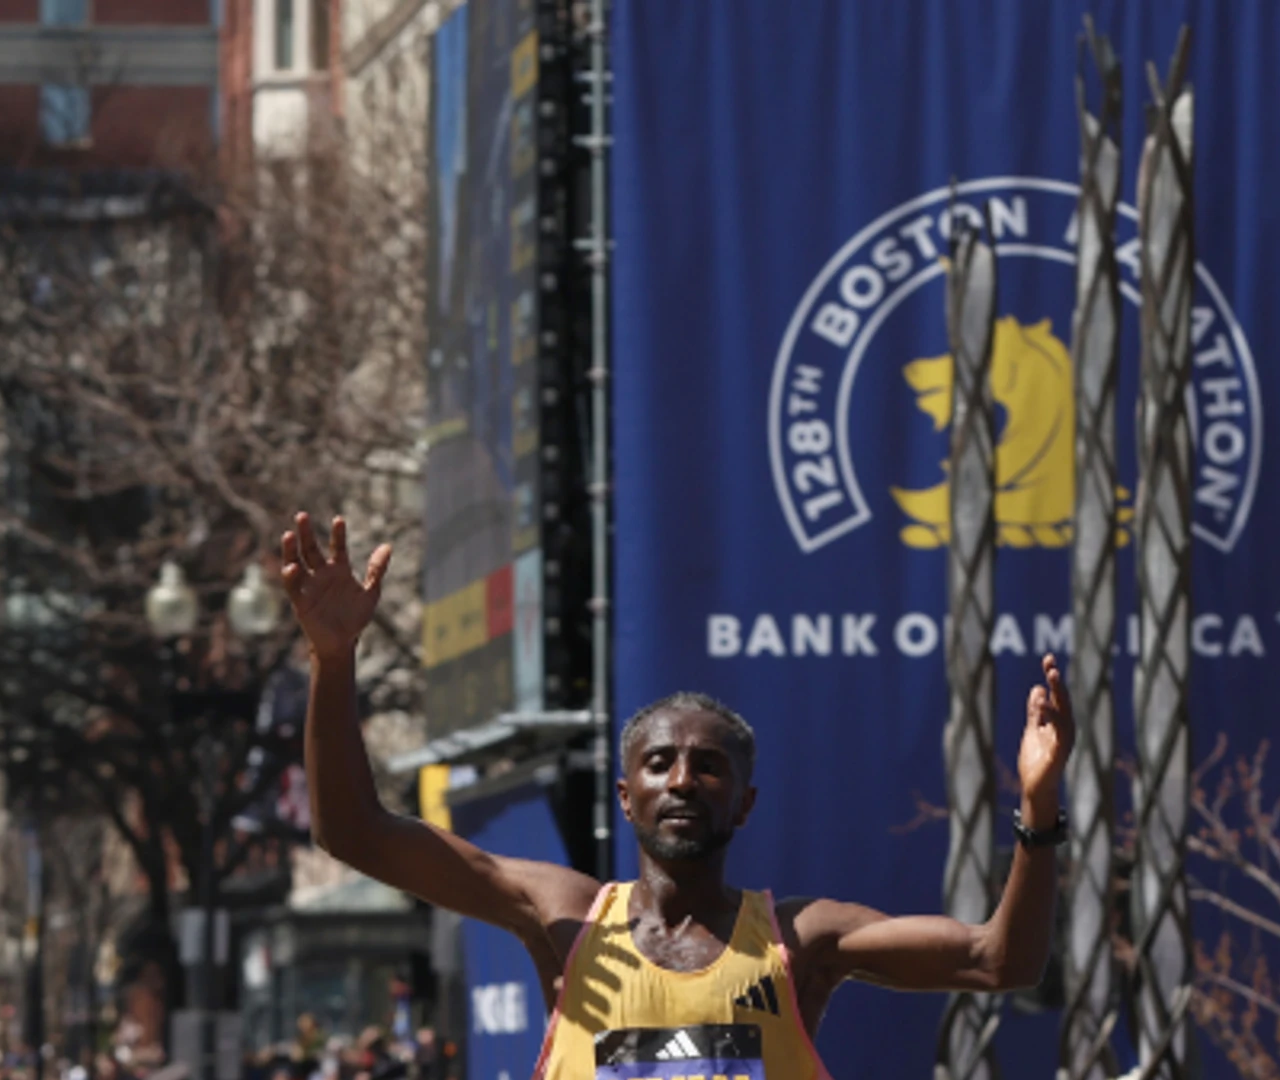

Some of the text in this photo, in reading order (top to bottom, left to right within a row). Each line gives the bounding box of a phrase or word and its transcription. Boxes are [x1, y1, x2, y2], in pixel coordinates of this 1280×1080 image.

[787, 364, 846, 521] 128TH
[707, 613, 879, 658] BANK
[989, 613, 1265, 658] AMICA
